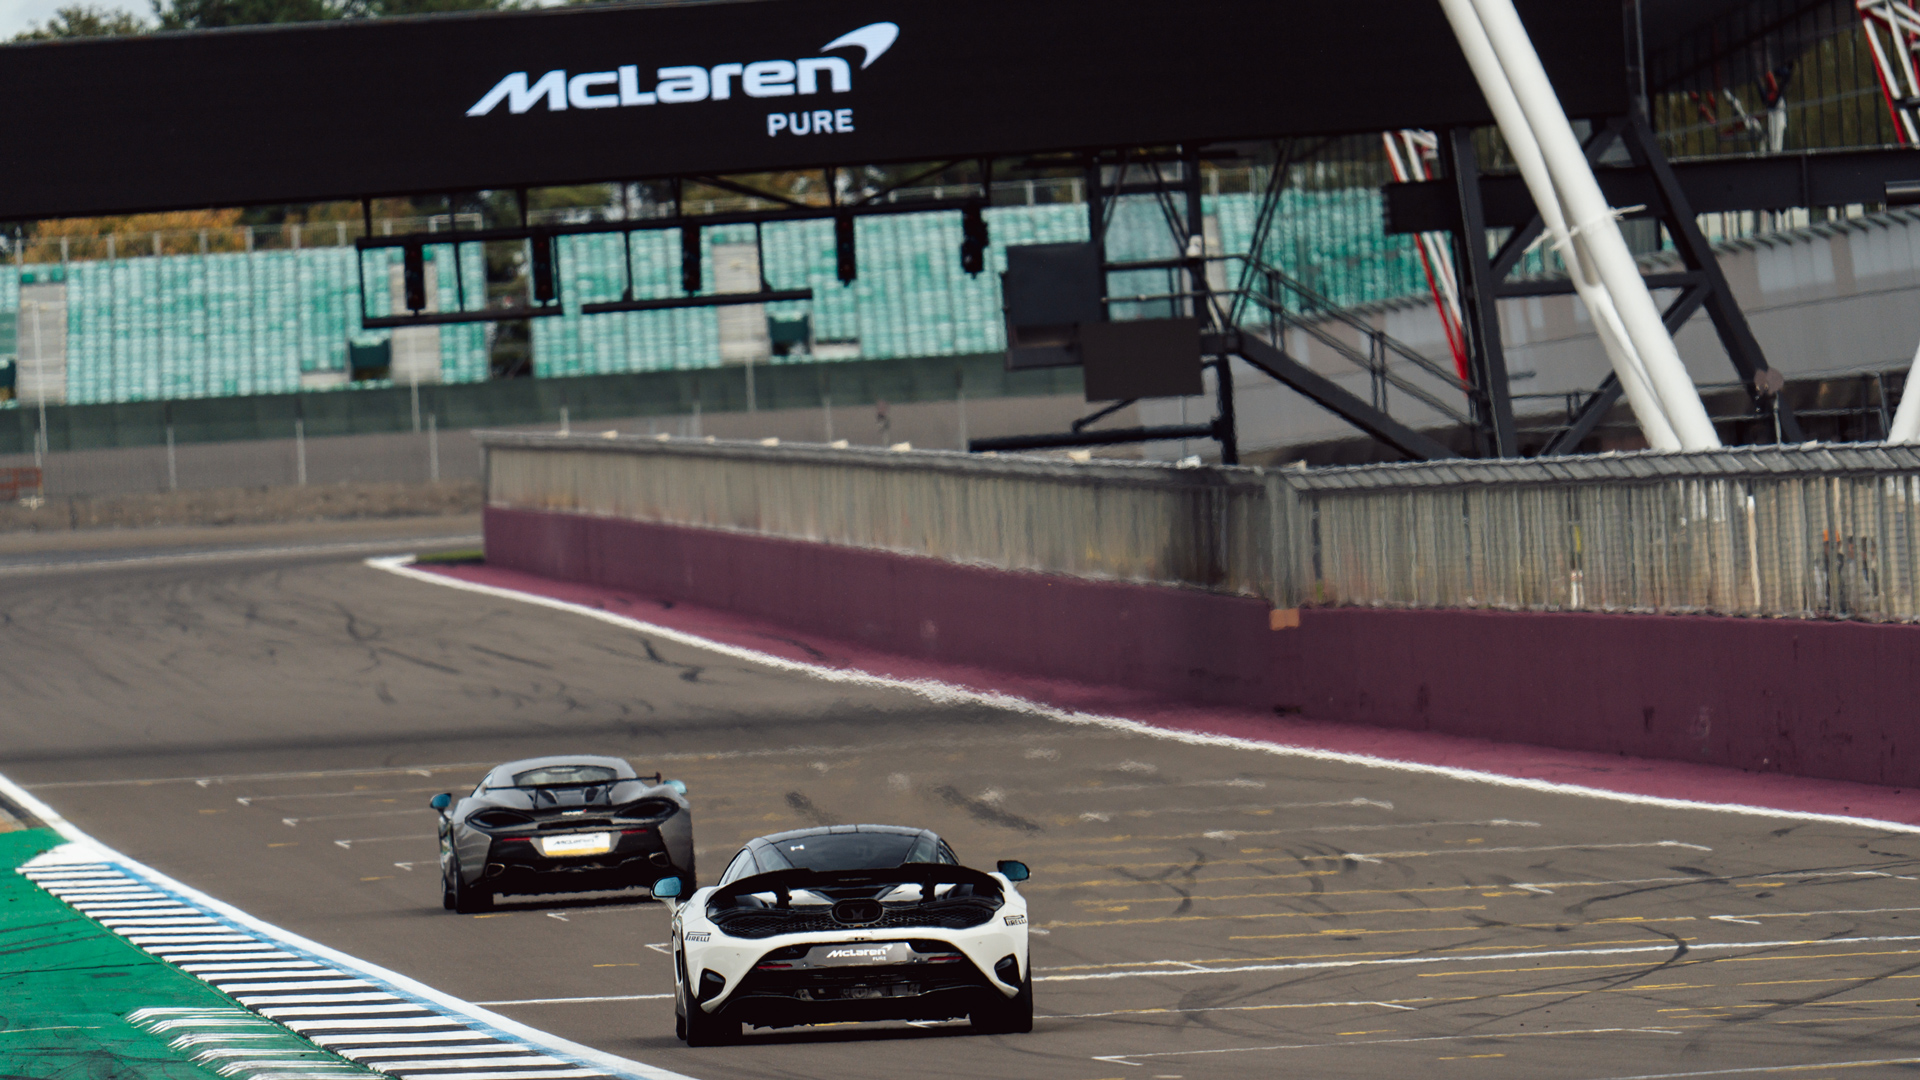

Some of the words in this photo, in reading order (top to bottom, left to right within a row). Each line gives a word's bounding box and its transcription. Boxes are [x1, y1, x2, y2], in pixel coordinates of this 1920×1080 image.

[466, 56, 852, 117] McLaren
[767, 109, 854, 137] PURE
[1003, 914, 1027, 926] PIRELLI
[685, 931, 711, 942] PIRELLI
[826, 948, 886, 958] McLaren
